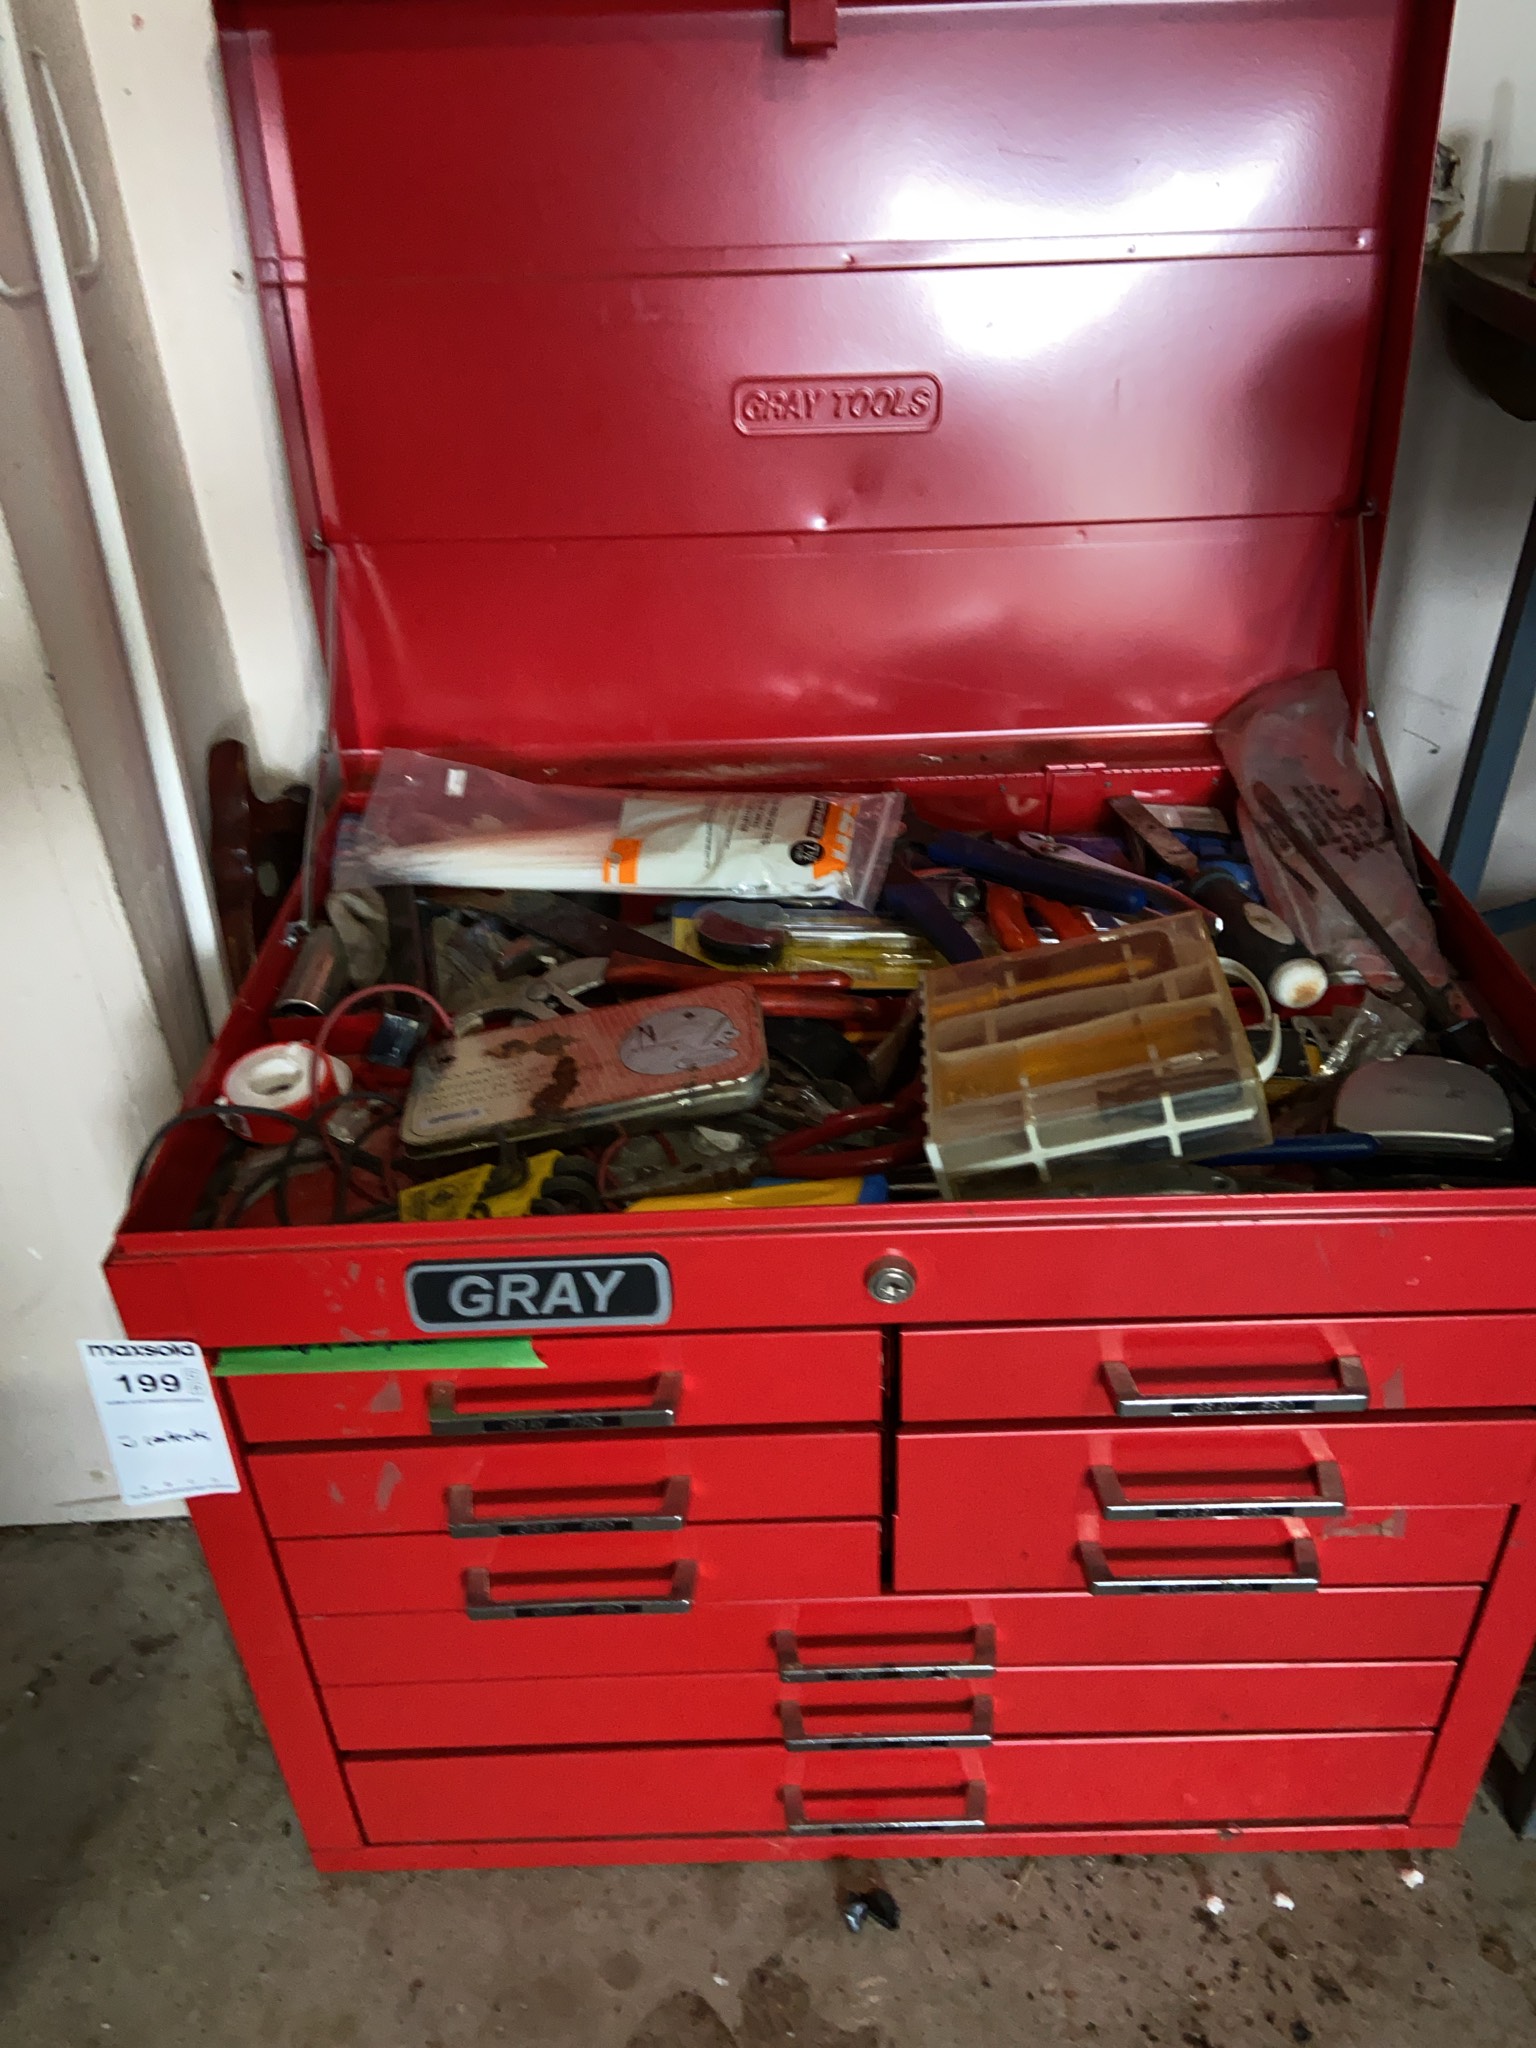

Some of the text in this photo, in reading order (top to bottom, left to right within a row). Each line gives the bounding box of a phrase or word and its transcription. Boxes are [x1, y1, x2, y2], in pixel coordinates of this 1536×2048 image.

[743, 385, 933, 422] GRAY TOOLS
[448, 1270, 626, 1318] GRAY
[115, 1373, 182, 1394] 199
